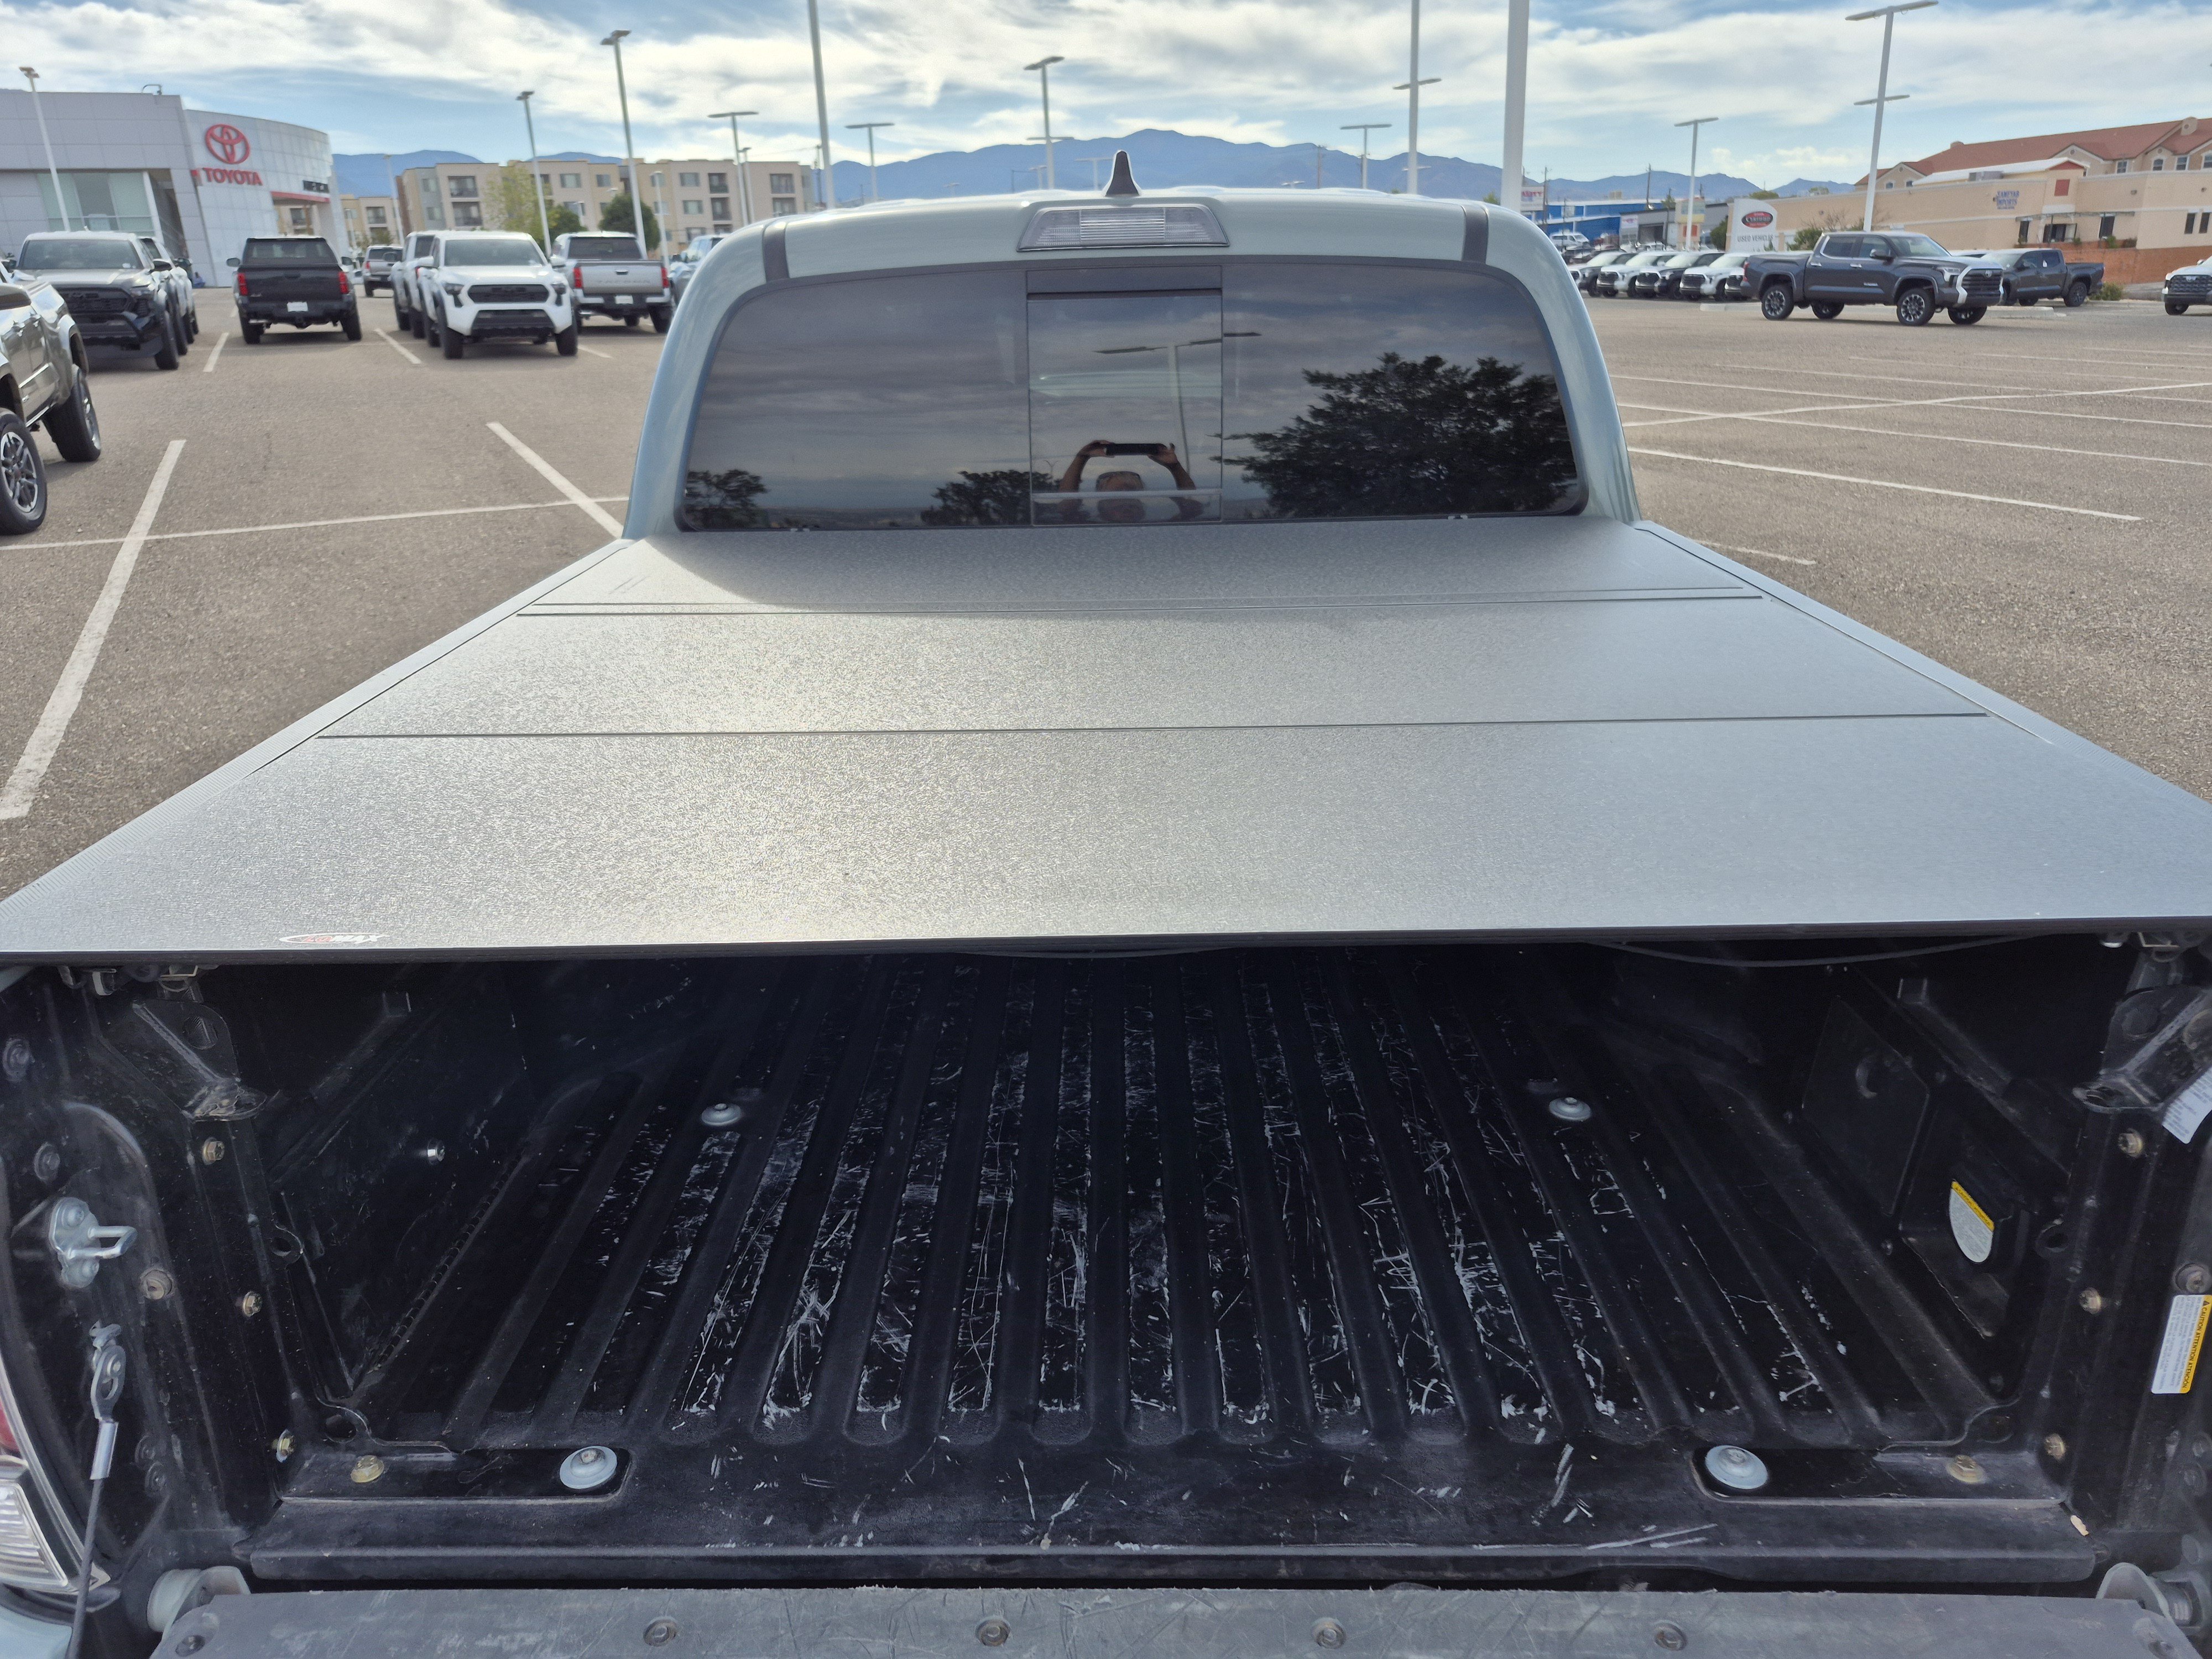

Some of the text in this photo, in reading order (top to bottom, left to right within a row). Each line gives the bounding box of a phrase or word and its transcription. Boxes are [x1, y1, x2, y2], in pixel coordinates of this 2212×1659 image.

[203, 168, 263, 186] TOYOTA
[2182, 1307, 2208, 1387] CAUTION ATTENTION ATENCIÓN
